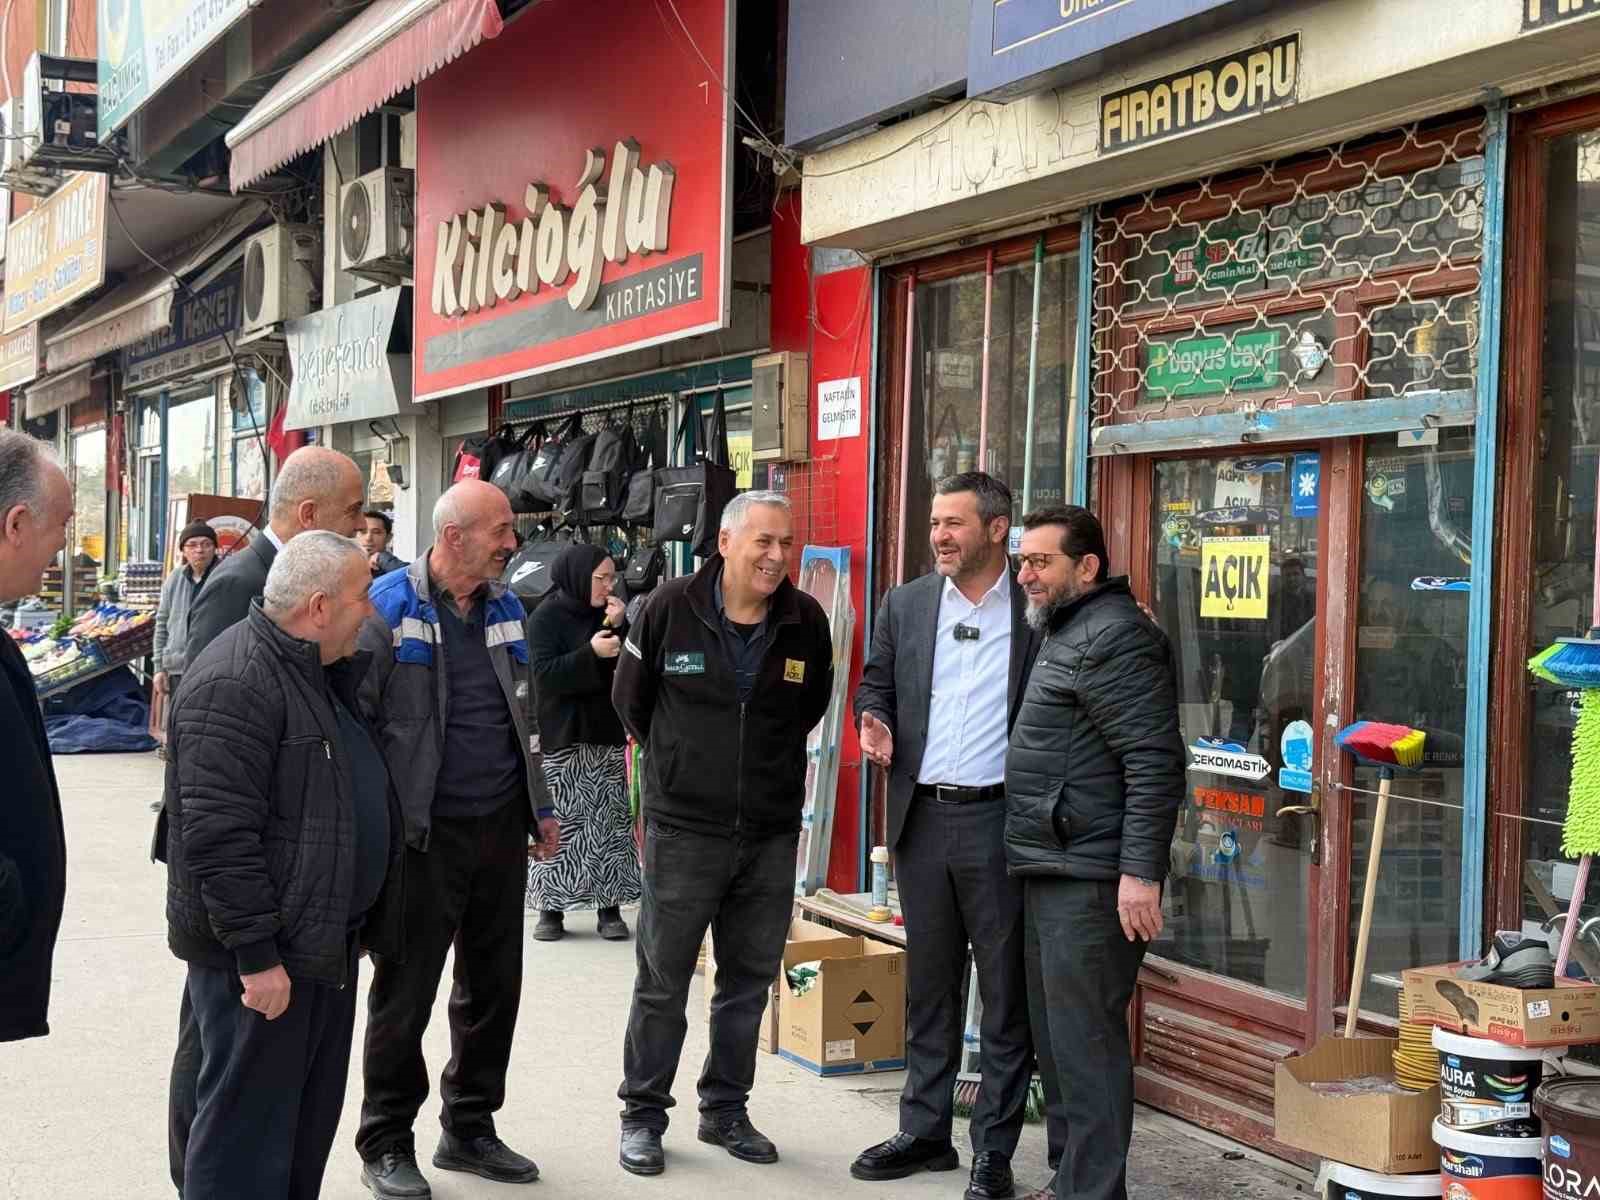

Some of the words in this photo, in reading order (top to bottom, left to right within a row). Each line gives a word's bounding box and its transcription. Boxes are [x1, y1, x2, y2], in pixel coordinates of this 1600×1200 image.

[1104, 41, 1296, 148] FIRATBORU
[432, 137, 674, 317] Kilcioğlu
[606, 267, 697, 321] KIRTASİYE
[297, 304, 384, 408] beyefendi
[1204, 555, 1263, 611] AÇIK
[1441, 1064, 1475, 1088] AURA
[1441, 1157, 1480, 1177] Marshall
